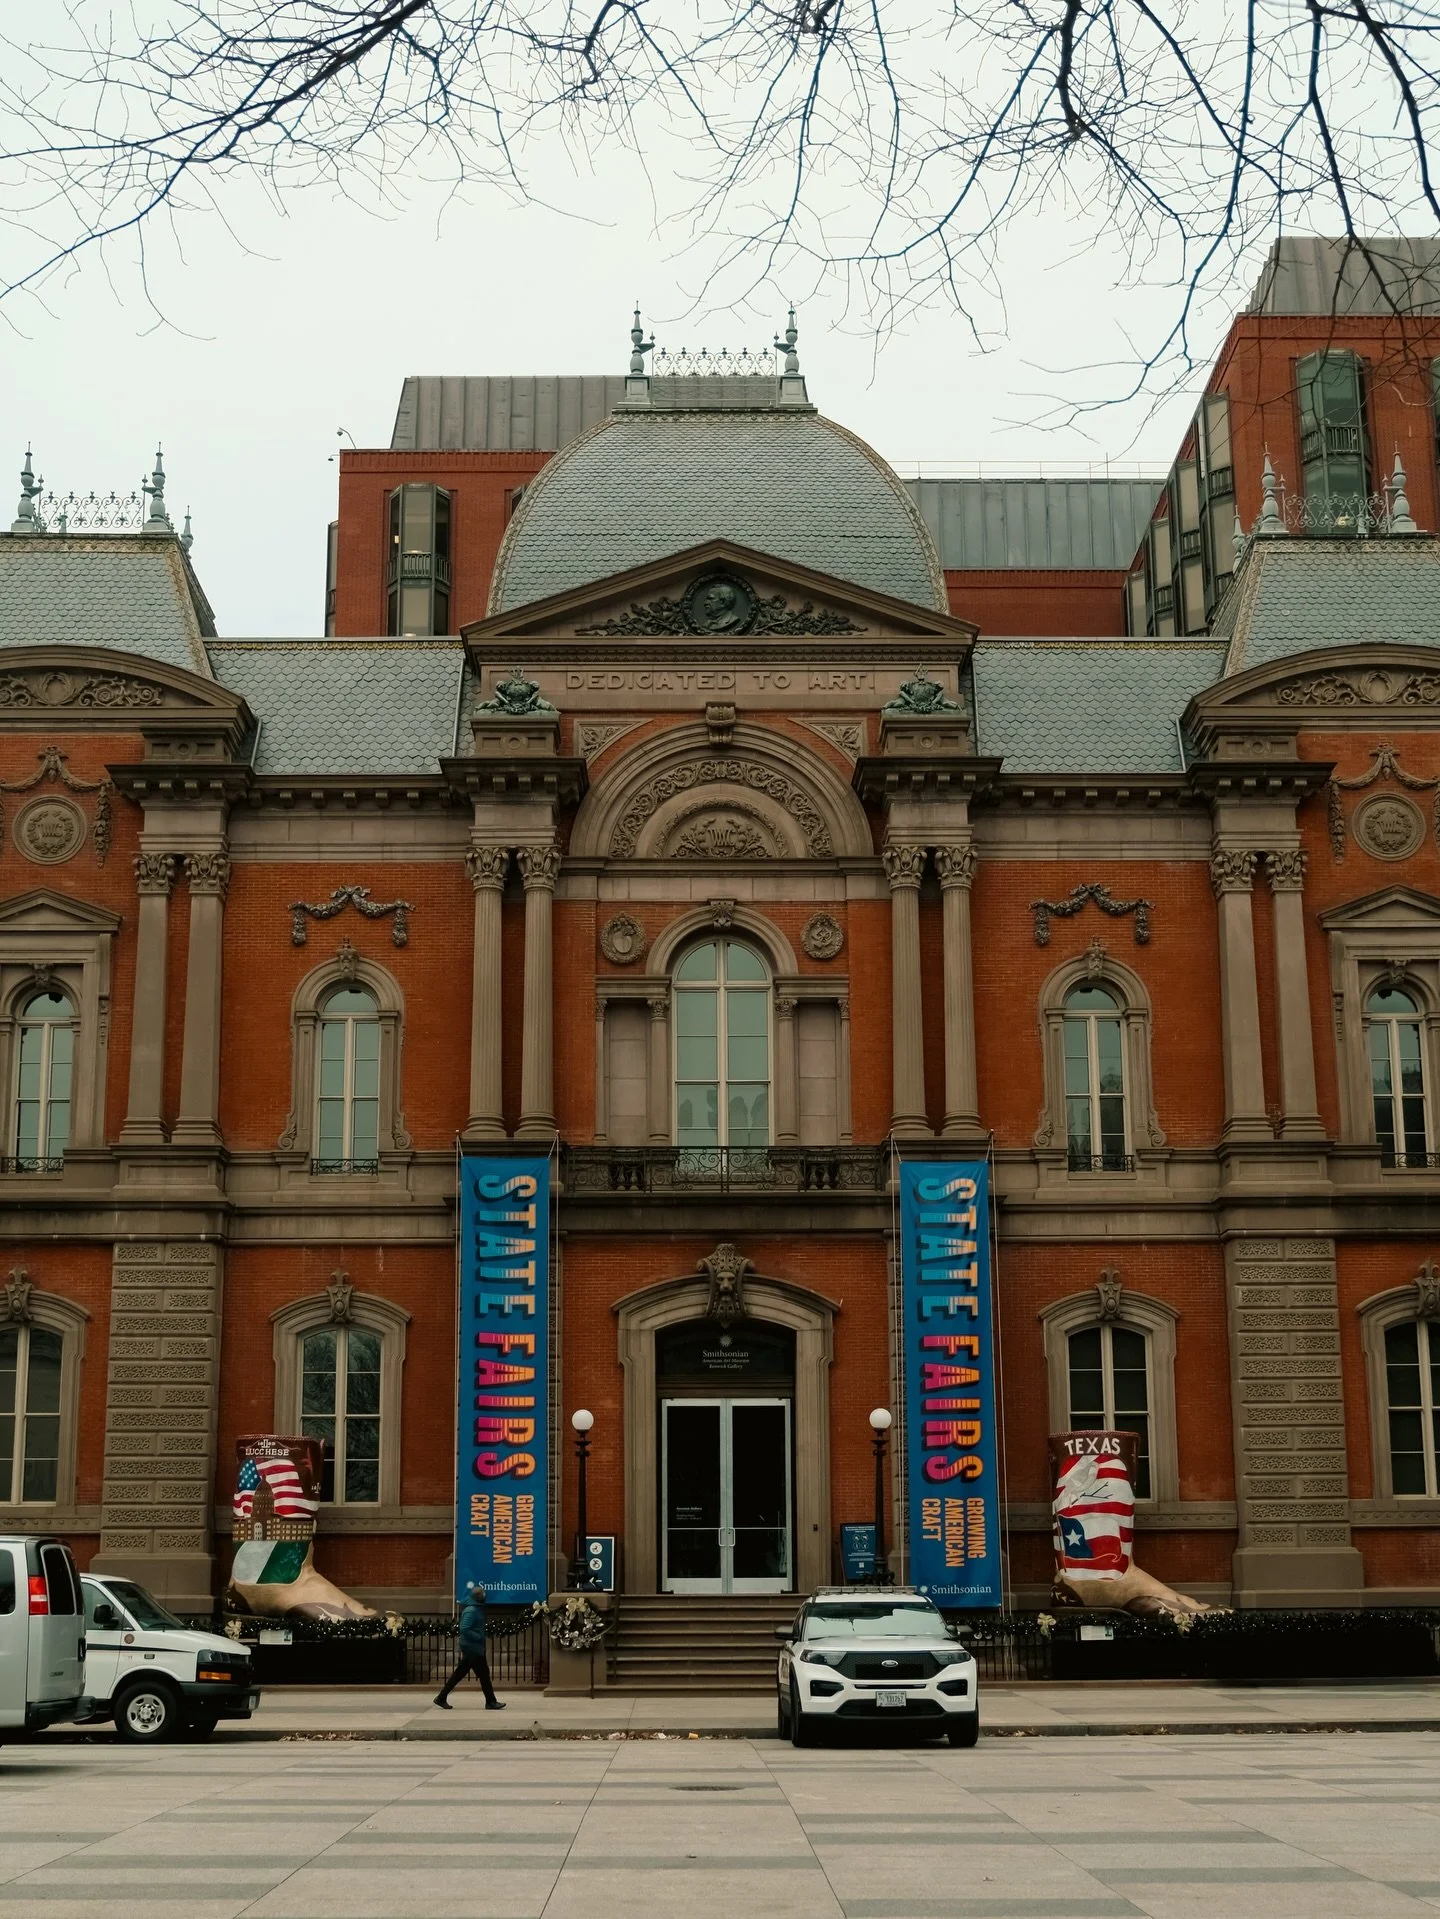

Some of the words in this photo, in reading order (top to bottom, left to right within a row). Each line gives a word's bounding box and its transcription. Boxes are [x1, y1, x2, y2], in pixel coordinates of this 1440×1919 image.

[566, 671, 736, 690] DEDICATED
[752, 671, 792, 690] TO
[477, 1174, 538, 1316] STATE
[918, 1177, 979, 1318] STATE
[702, 1349, 749, 1357] Smithsonian
[475, 1331, 537, 1478] FAIRS
[923, 1335, 984, 1481] FAIRS
[245, 1448, 290, 1456] LUCCHESE
[1064, 1437, 1121, 1456] TEXAS
[470, 1493, 490, 1537] CRAFT
[493, 1494, 513, 1564] AMERICAN
[516, 1494, 534, 1556] GROWING
[921, 1498, 941, 1541] CRAFT
[945, 1497, 965, 1567] AMERICAN
[967, 1497, 987, 1559] GROWING
[478, 1580, 537, 1591] Smithsonian
[931, 1584, 992, 1594] Smithsonian
